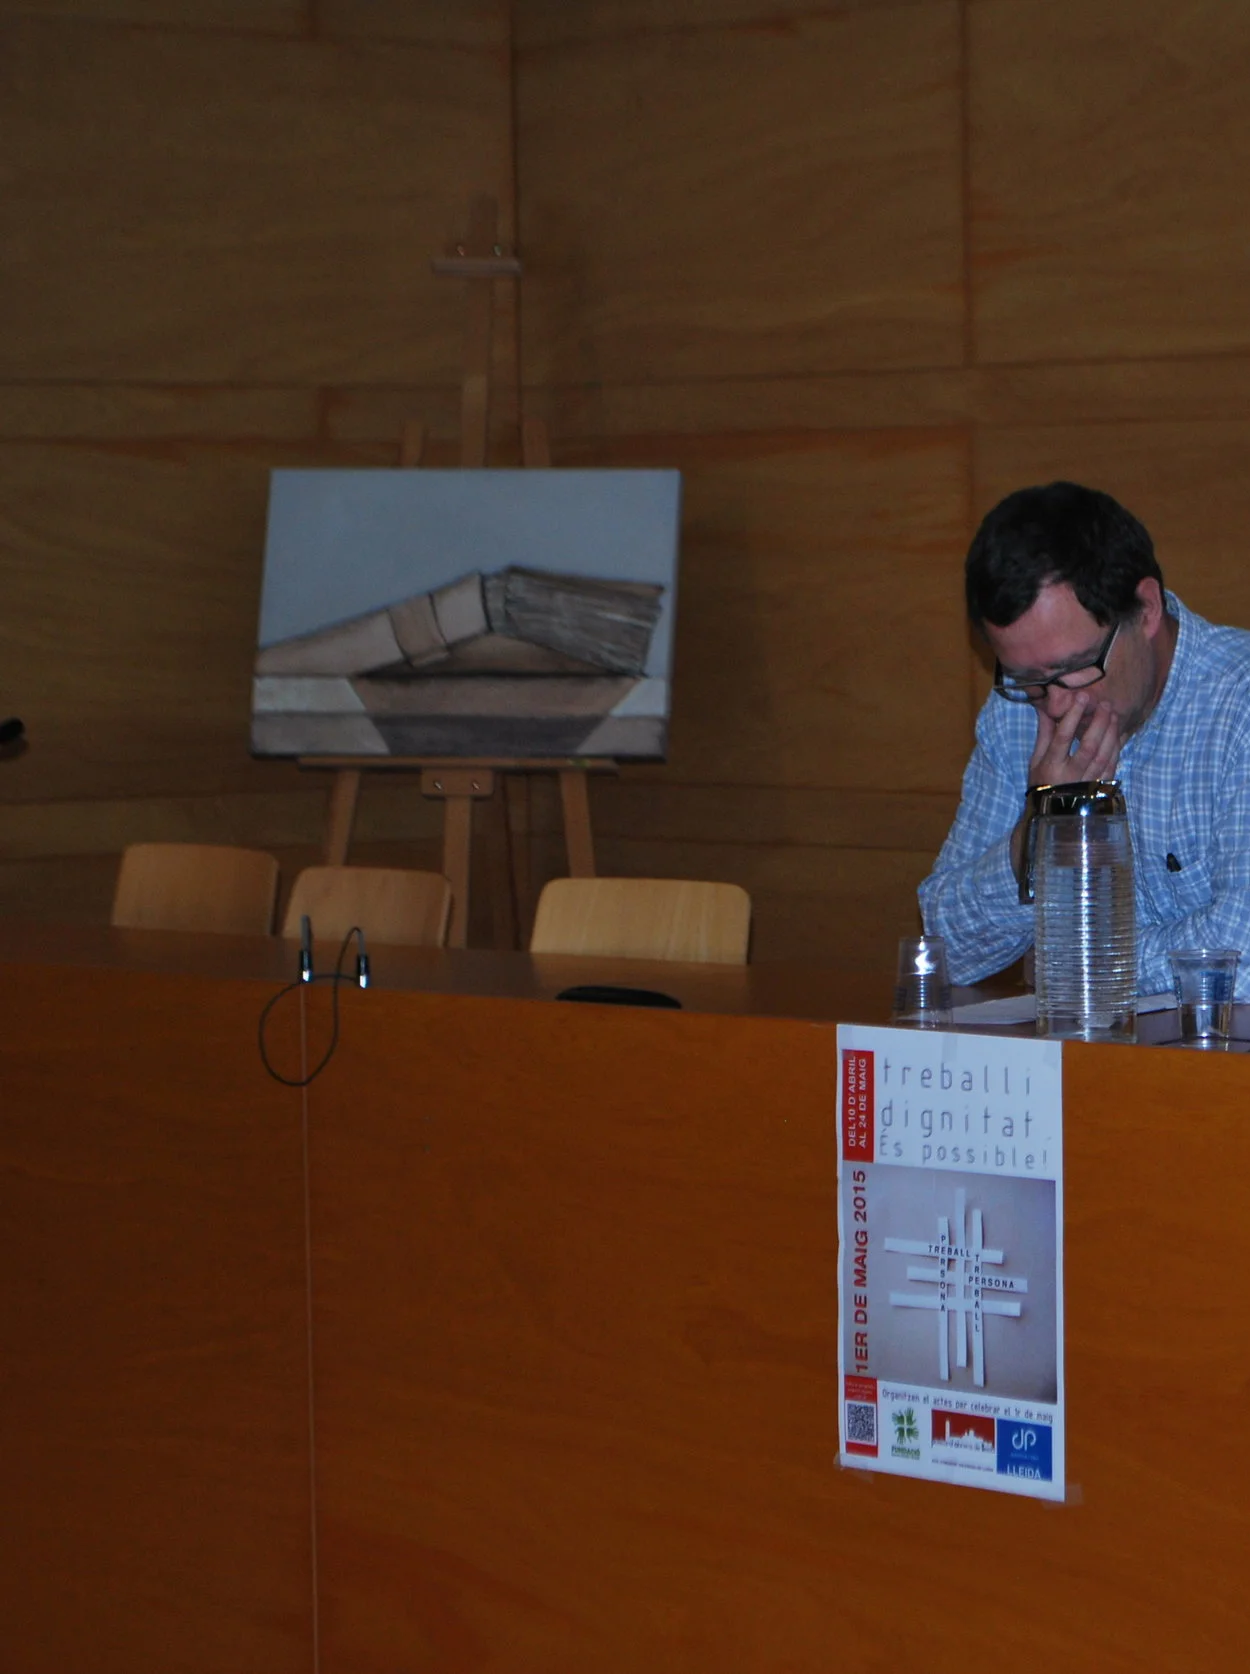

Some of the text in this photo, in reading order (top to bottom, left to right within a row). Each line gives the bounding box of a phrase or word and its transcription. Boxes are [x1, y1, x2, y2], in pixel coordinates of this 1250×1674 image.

[848, 1056, 856, 1147] DEL 10 D'ABRIL
[858, 1058, 867, 1149] AL 24 DE MAIG
[880, 1099, 1033, 1139] dignitat
[852, 1169, 867, 1223] 2015
[853, 1230, 868, 1288] MAIG
[928, 1244, 970, 1258] TREBALL
[968, 1275, 1015, 1289] PERSONA
[853, 1294, 868, 1325] DE
[854, 1332, 869, 1373] 1ER
[955, 1400, 968, 1409] per
[970, 1403, 1000, 1414] celebrar
[1004, 1407, 1011, 1416] el
[1024, 1408, 1034, 1419] de
[1007, 1463, 1041, 1479] LLEIDA
